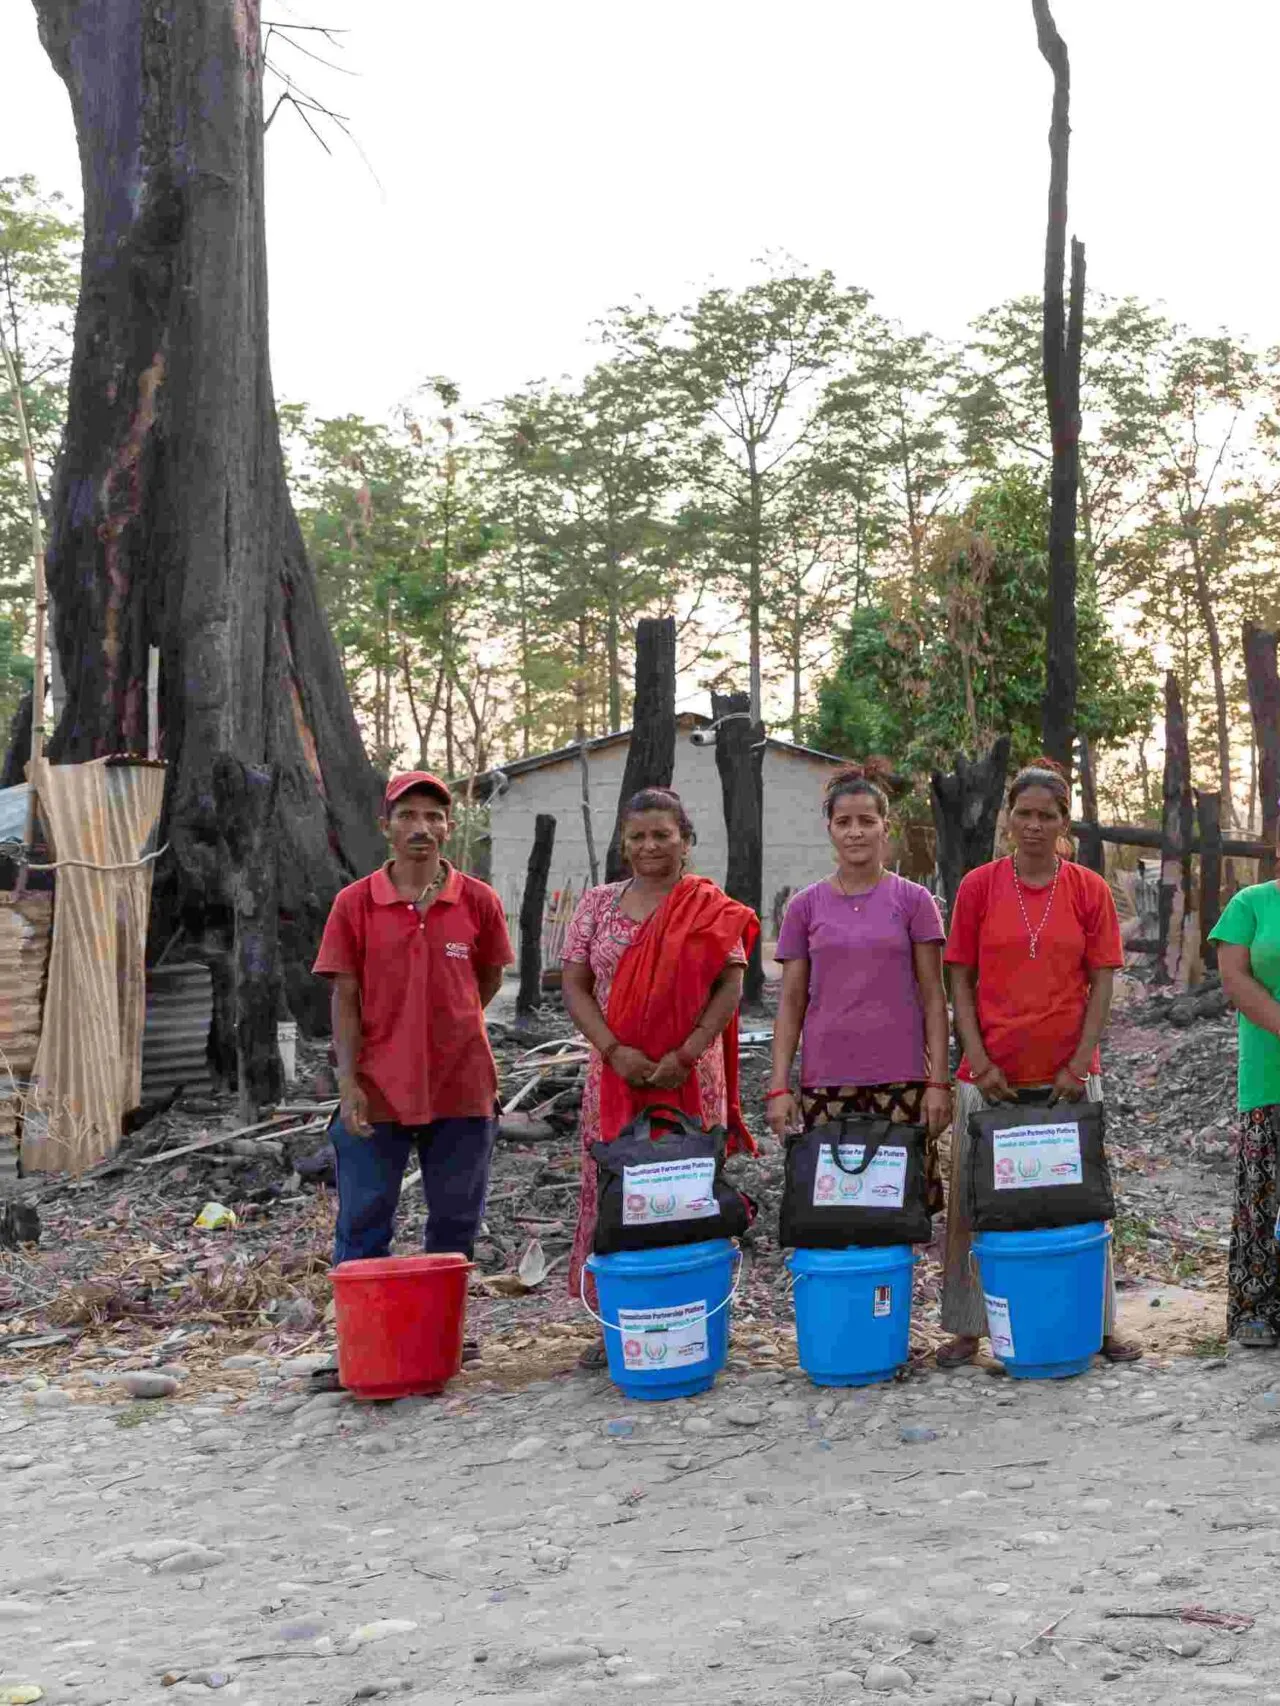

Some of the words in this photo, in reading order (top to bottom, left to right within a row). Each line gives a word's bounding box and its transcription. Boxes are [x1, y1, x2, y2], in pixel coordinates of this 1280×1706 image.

[1027, 1128, 1055, 1137] Partnership
[660, 1163, 692, 1174] Partnership
[692, 1161, 714, 1169] Platform
[652, 1309, 683, 1319] Partnership
[684, 1304, 705, 1314] Platform
